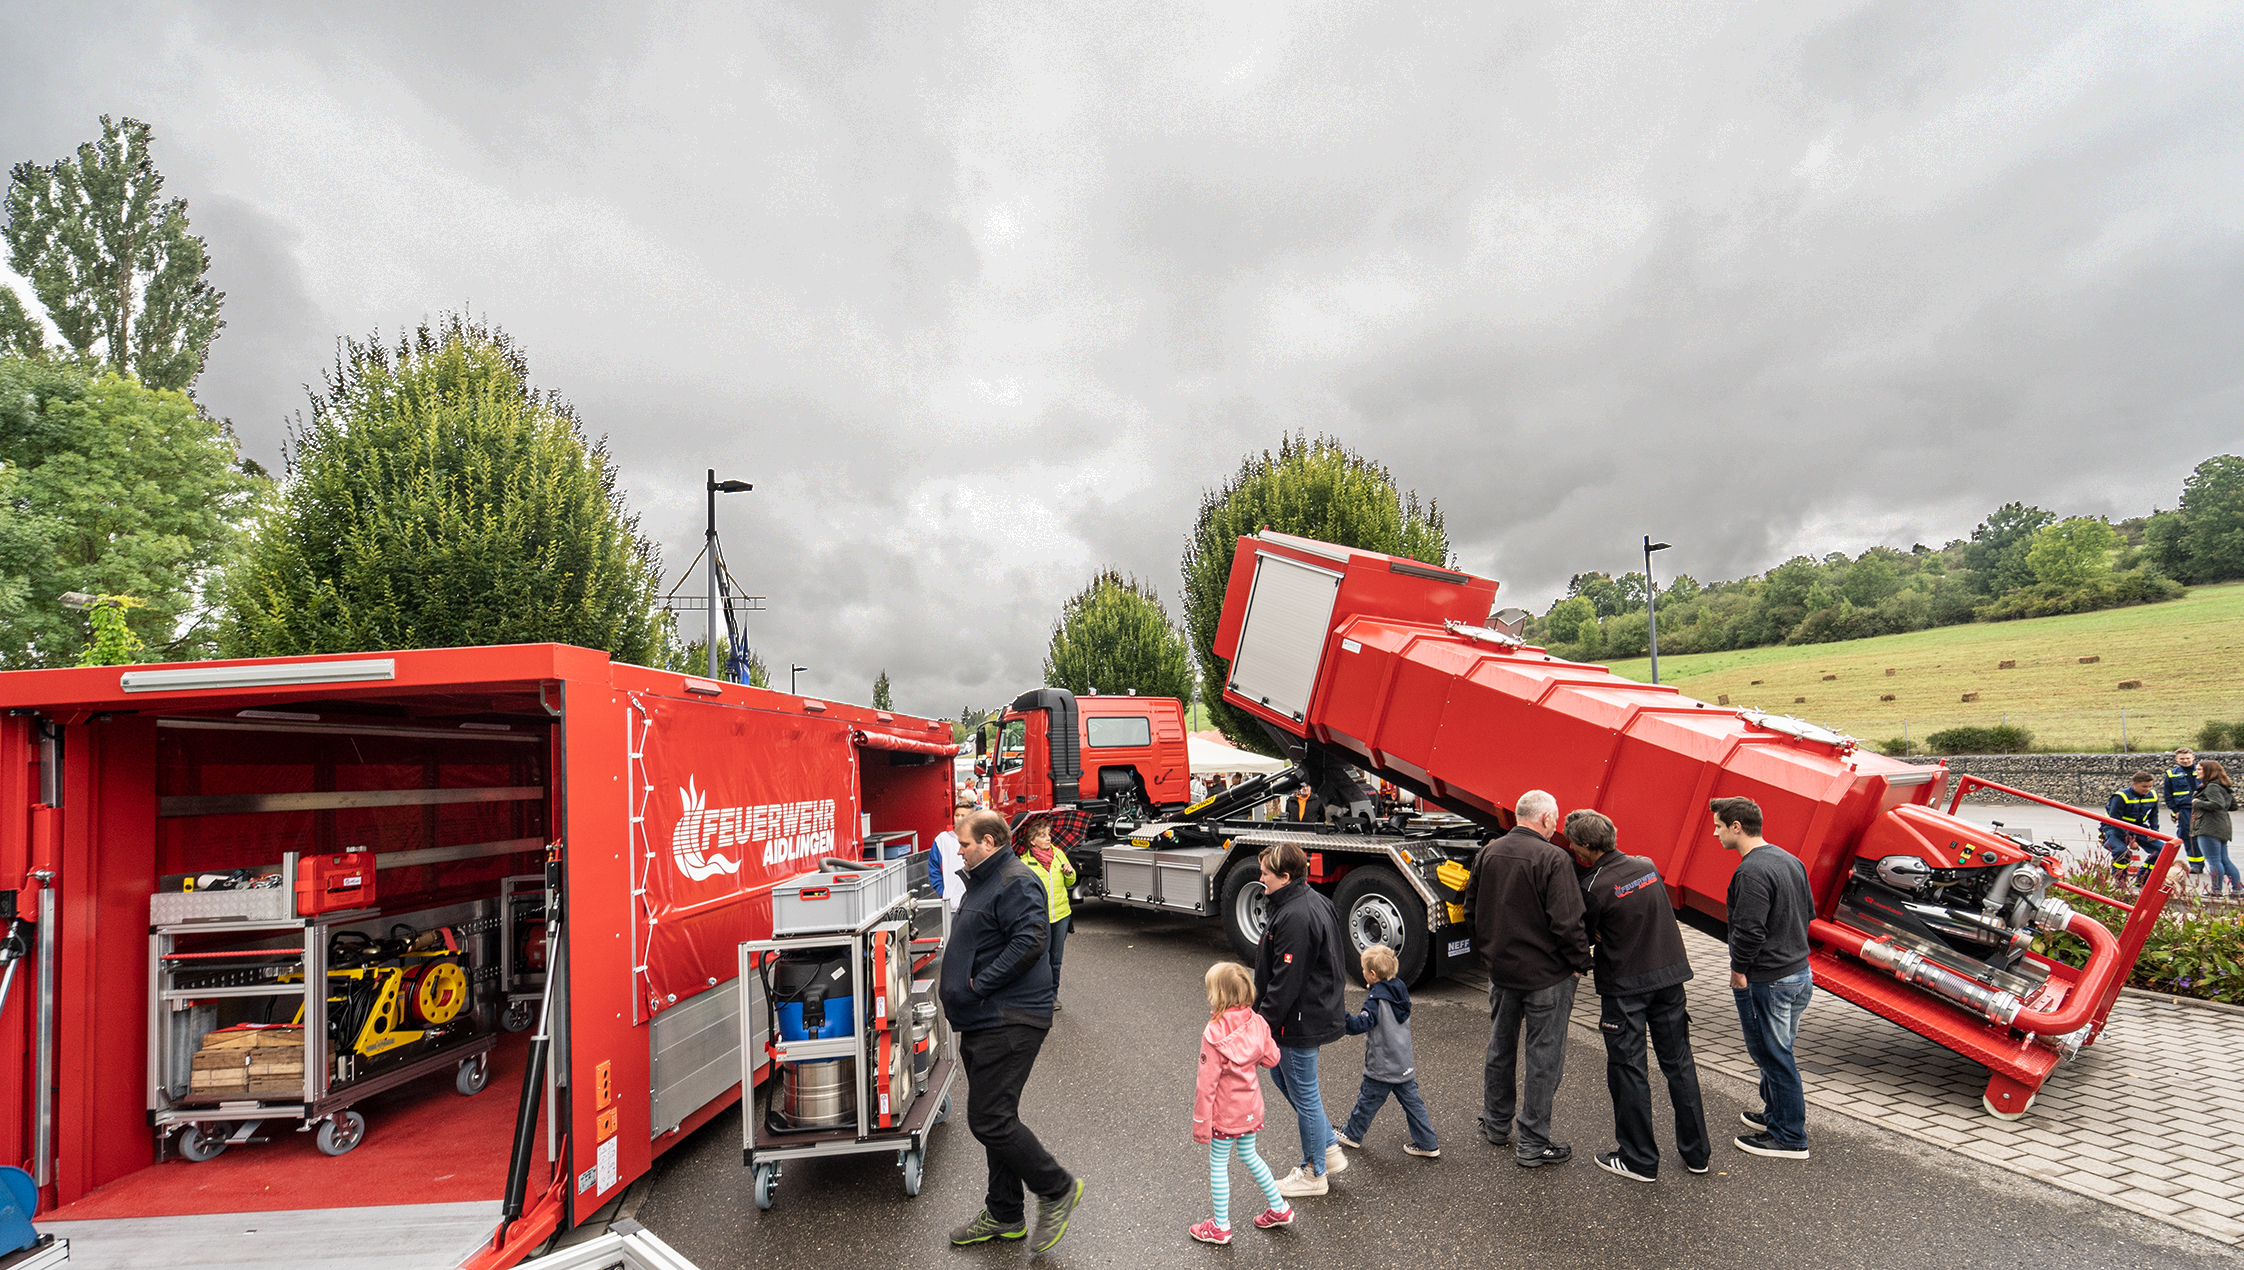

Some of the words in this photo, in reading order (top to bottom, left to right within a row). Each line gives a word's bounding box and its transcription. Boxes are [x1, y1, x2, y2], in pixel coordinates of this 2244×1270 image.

[701, 799, 835, 850] FEUERWEHR
[763, 829, 834, 866] AIDLINGEN
[1448, 939, 1470, 951] NEFF
